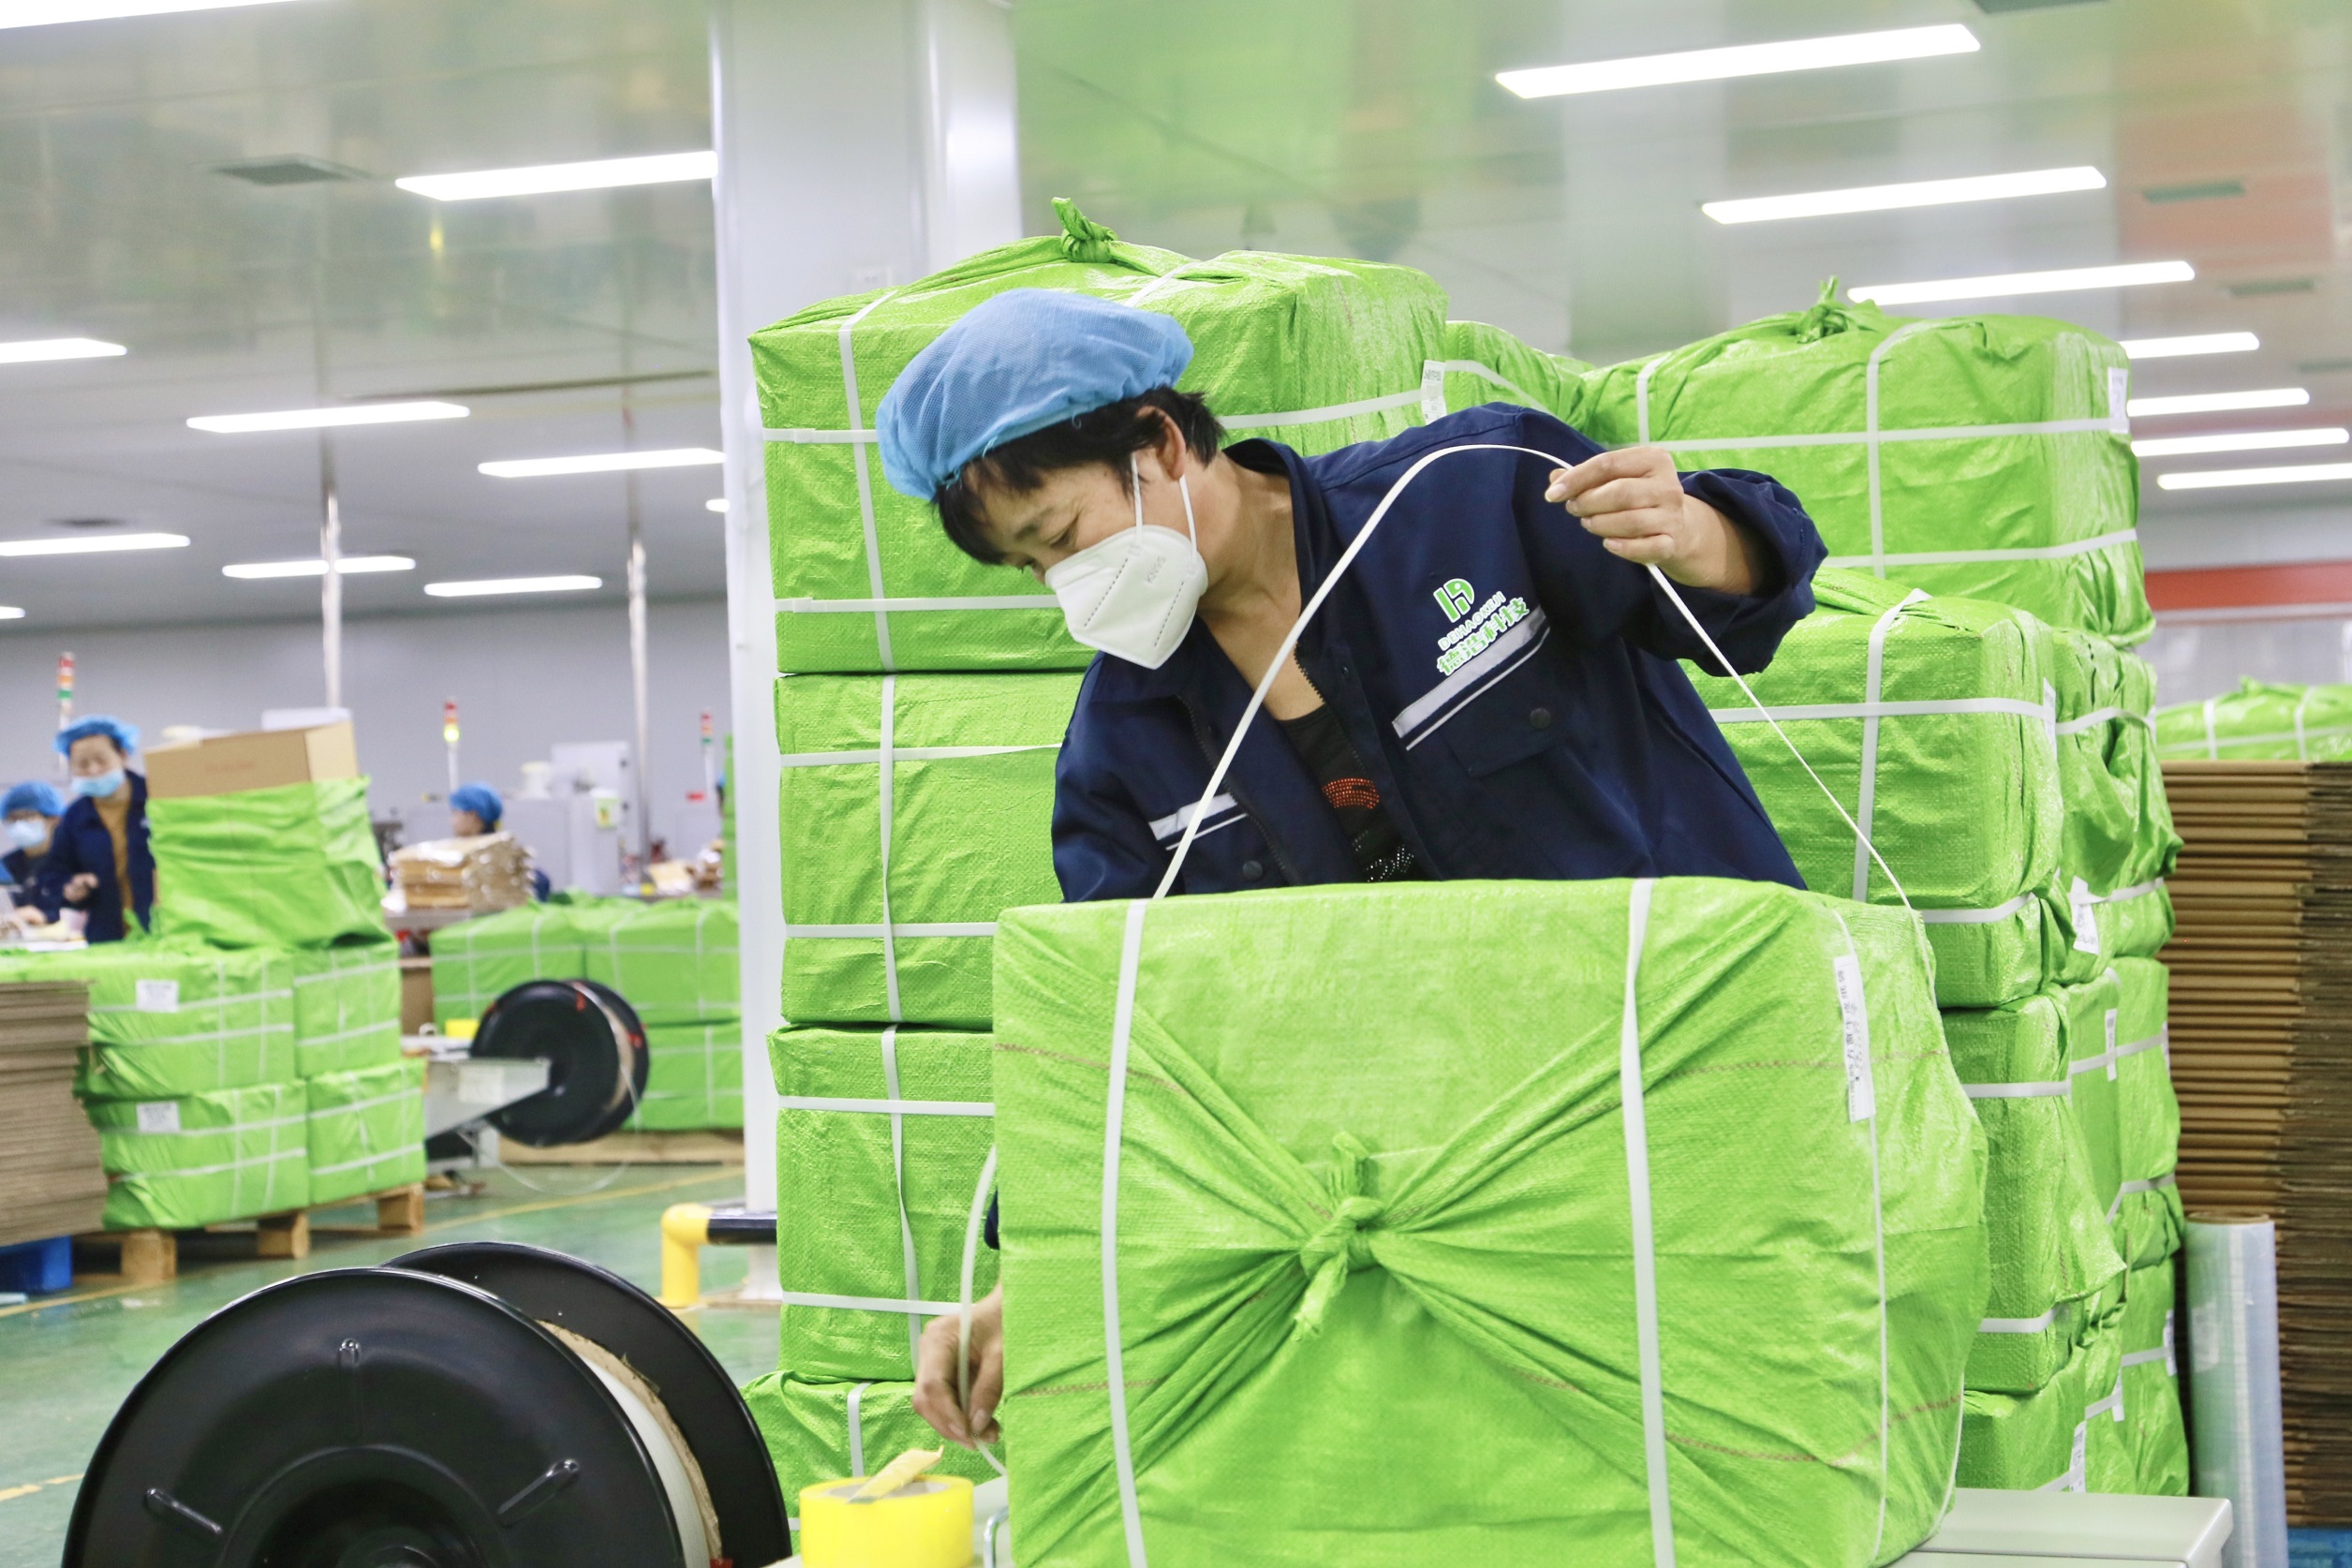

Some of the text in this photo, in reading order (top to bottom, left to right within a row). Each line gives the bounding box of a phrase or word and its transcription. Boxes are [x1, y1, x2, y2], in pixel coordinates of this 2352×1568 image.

[1437, 598, 1530, 675] 德浩科技
[1438, 591, 1506, 650] DEHAOKEJI
